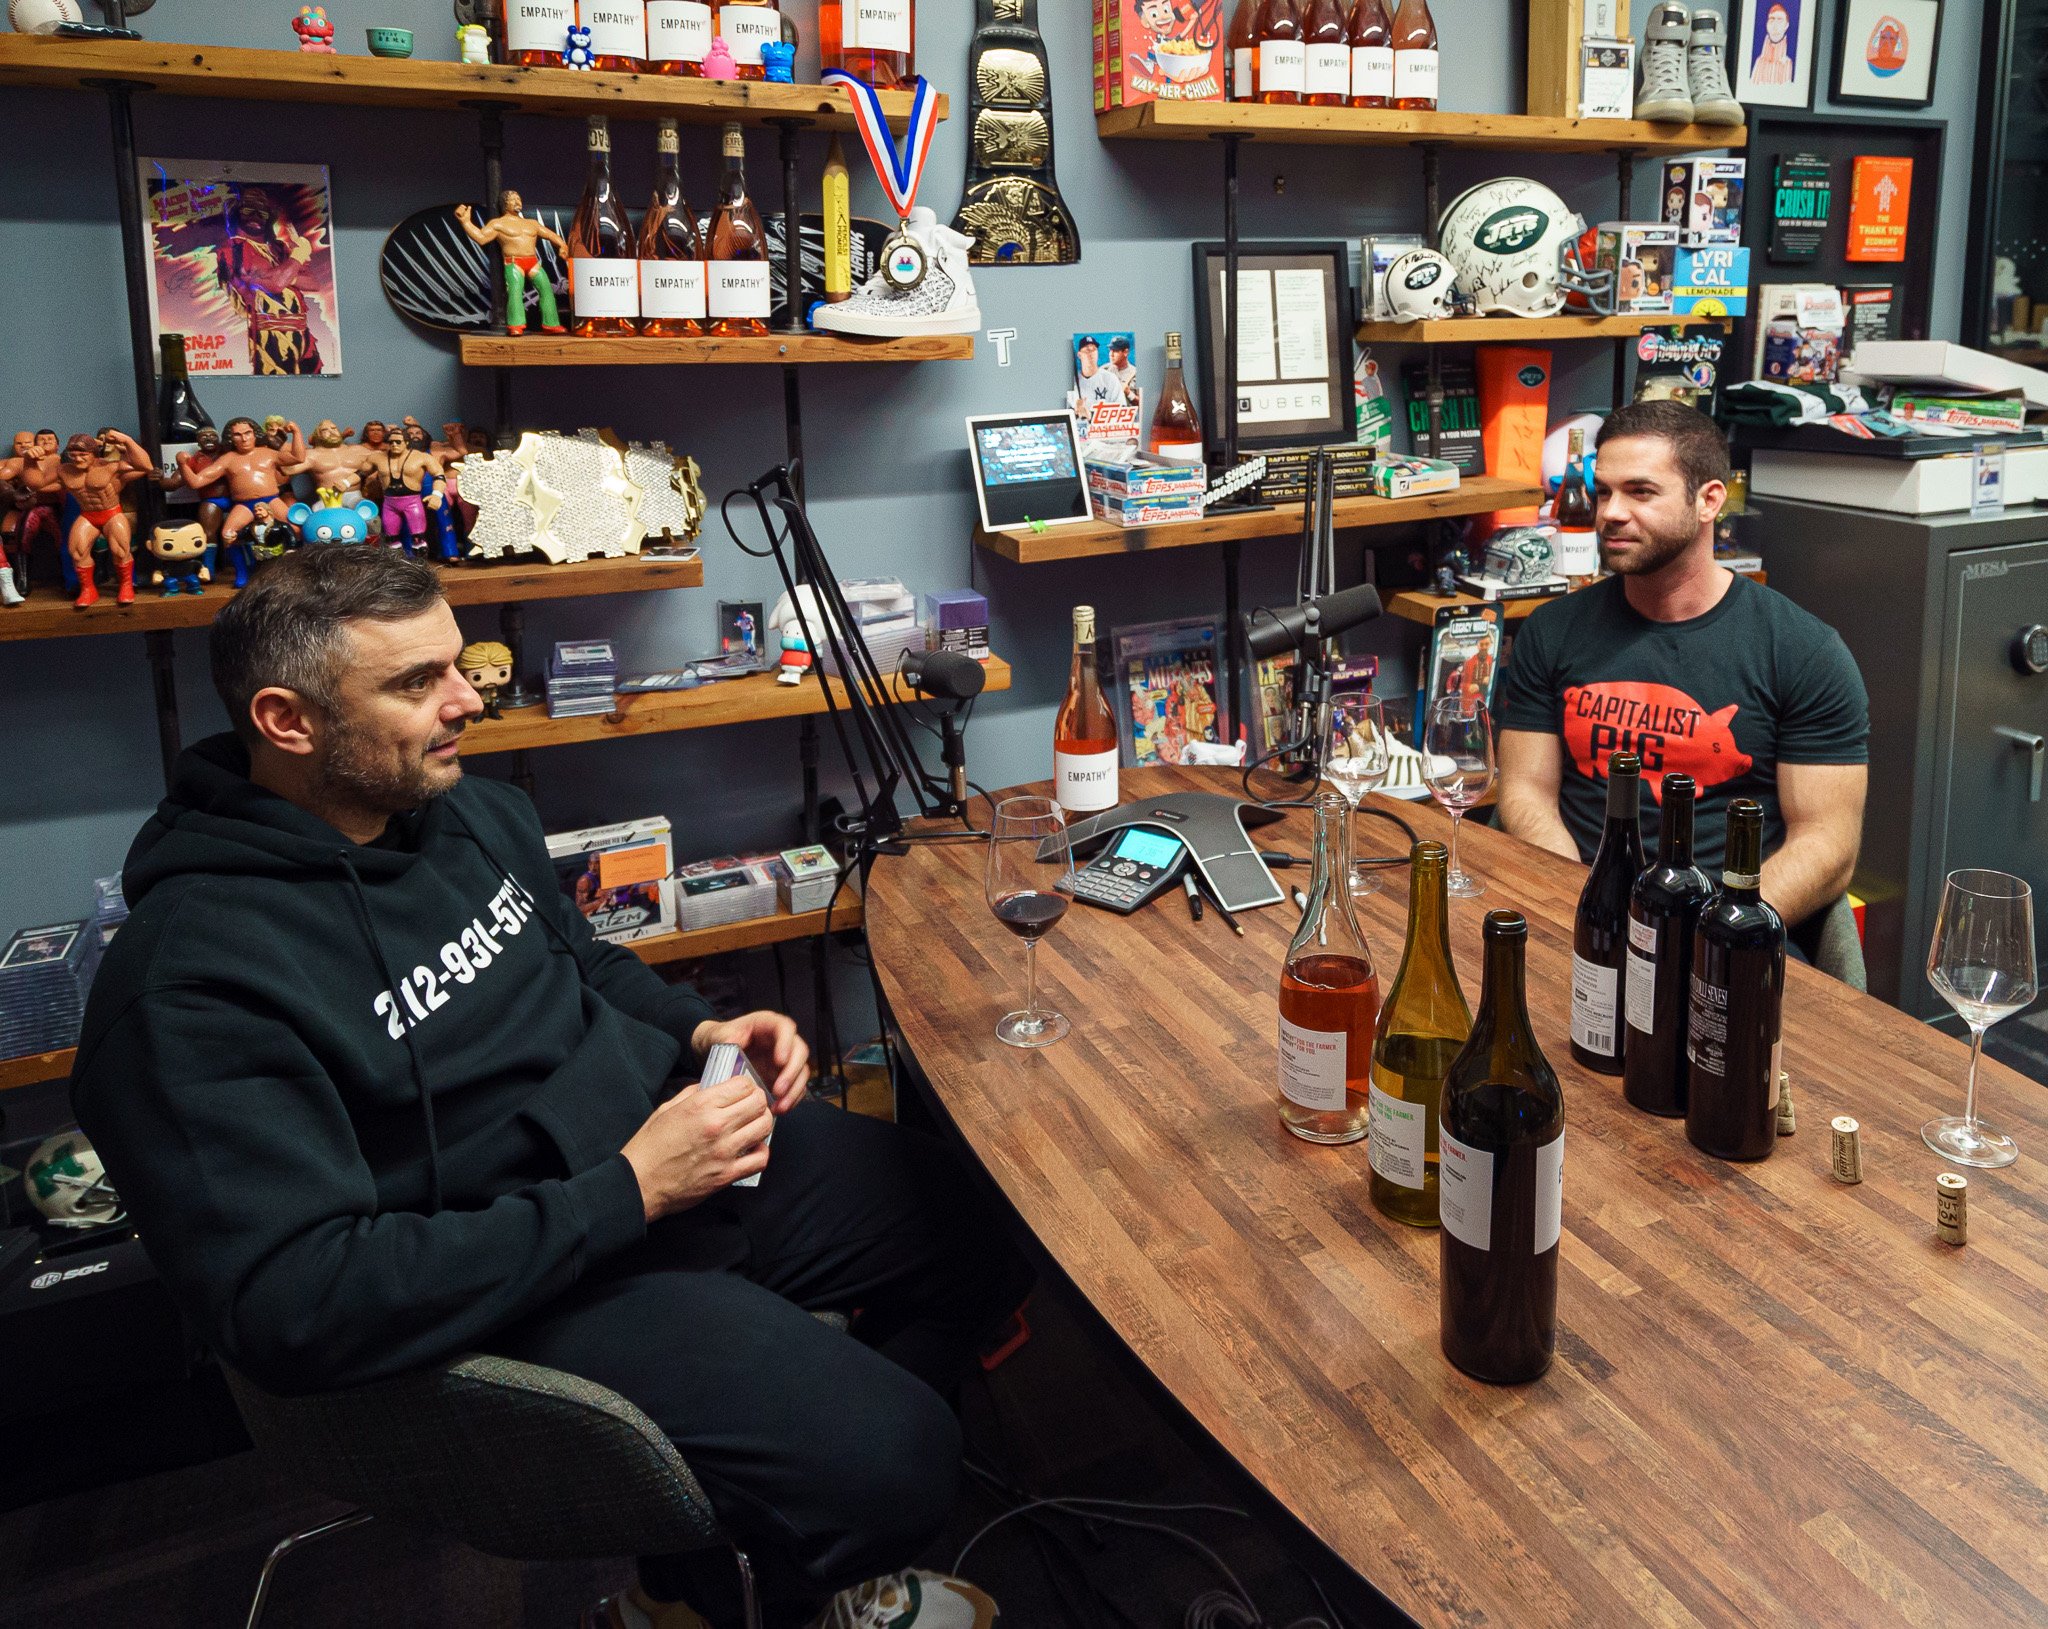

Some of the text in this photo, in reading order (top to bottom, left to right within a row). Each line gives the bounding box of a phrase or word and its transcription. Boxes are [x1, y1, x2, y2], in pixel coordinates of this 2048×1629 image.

[520, 6, 564, 20] EMPATHY
[593, 12, 635, 26] EMPATHY
[860, 9, 897, 22] EMPATHY
[660, 18, 701, 32] EMPATHY
[736, 23, 774, 37] EMPATHY
[1131, 75, 1219, 99] VAY-NER-CHUK!
[1592, 105, 1621, 113] JETS
[1775, 188, 1831, 219] CRUSH IT!
[1482, 212, 1540, 246] JETS
[1859, 225, 1905, 235] THANK YOU
[850, 230, 865, 279] HAWK
[1692, 251, 1733, 268] LYRI
[589, 276, 630, 287] EMPATHY
[655, 278, 695, 288] EMPATHY
[721, 278, 761, 289] EMPATHY
[1691, 268, 1731, 286] CAL
[183, 334, 225, 351] SNAP
[186, 358, 233, 371] LIM JIM
[1258, 395, 1322, 410] UBER
[1409, 396, 1460, 431] CRSH
[1576, 690, 1701, 738] CAPITALIST
[1590, 723, 1665, 773] PIG
[1068, 771, 1107, 782] EMPATHY
[596, 911, 641, 929] RIZM
[62, 1261, 110, 1281] SGC
